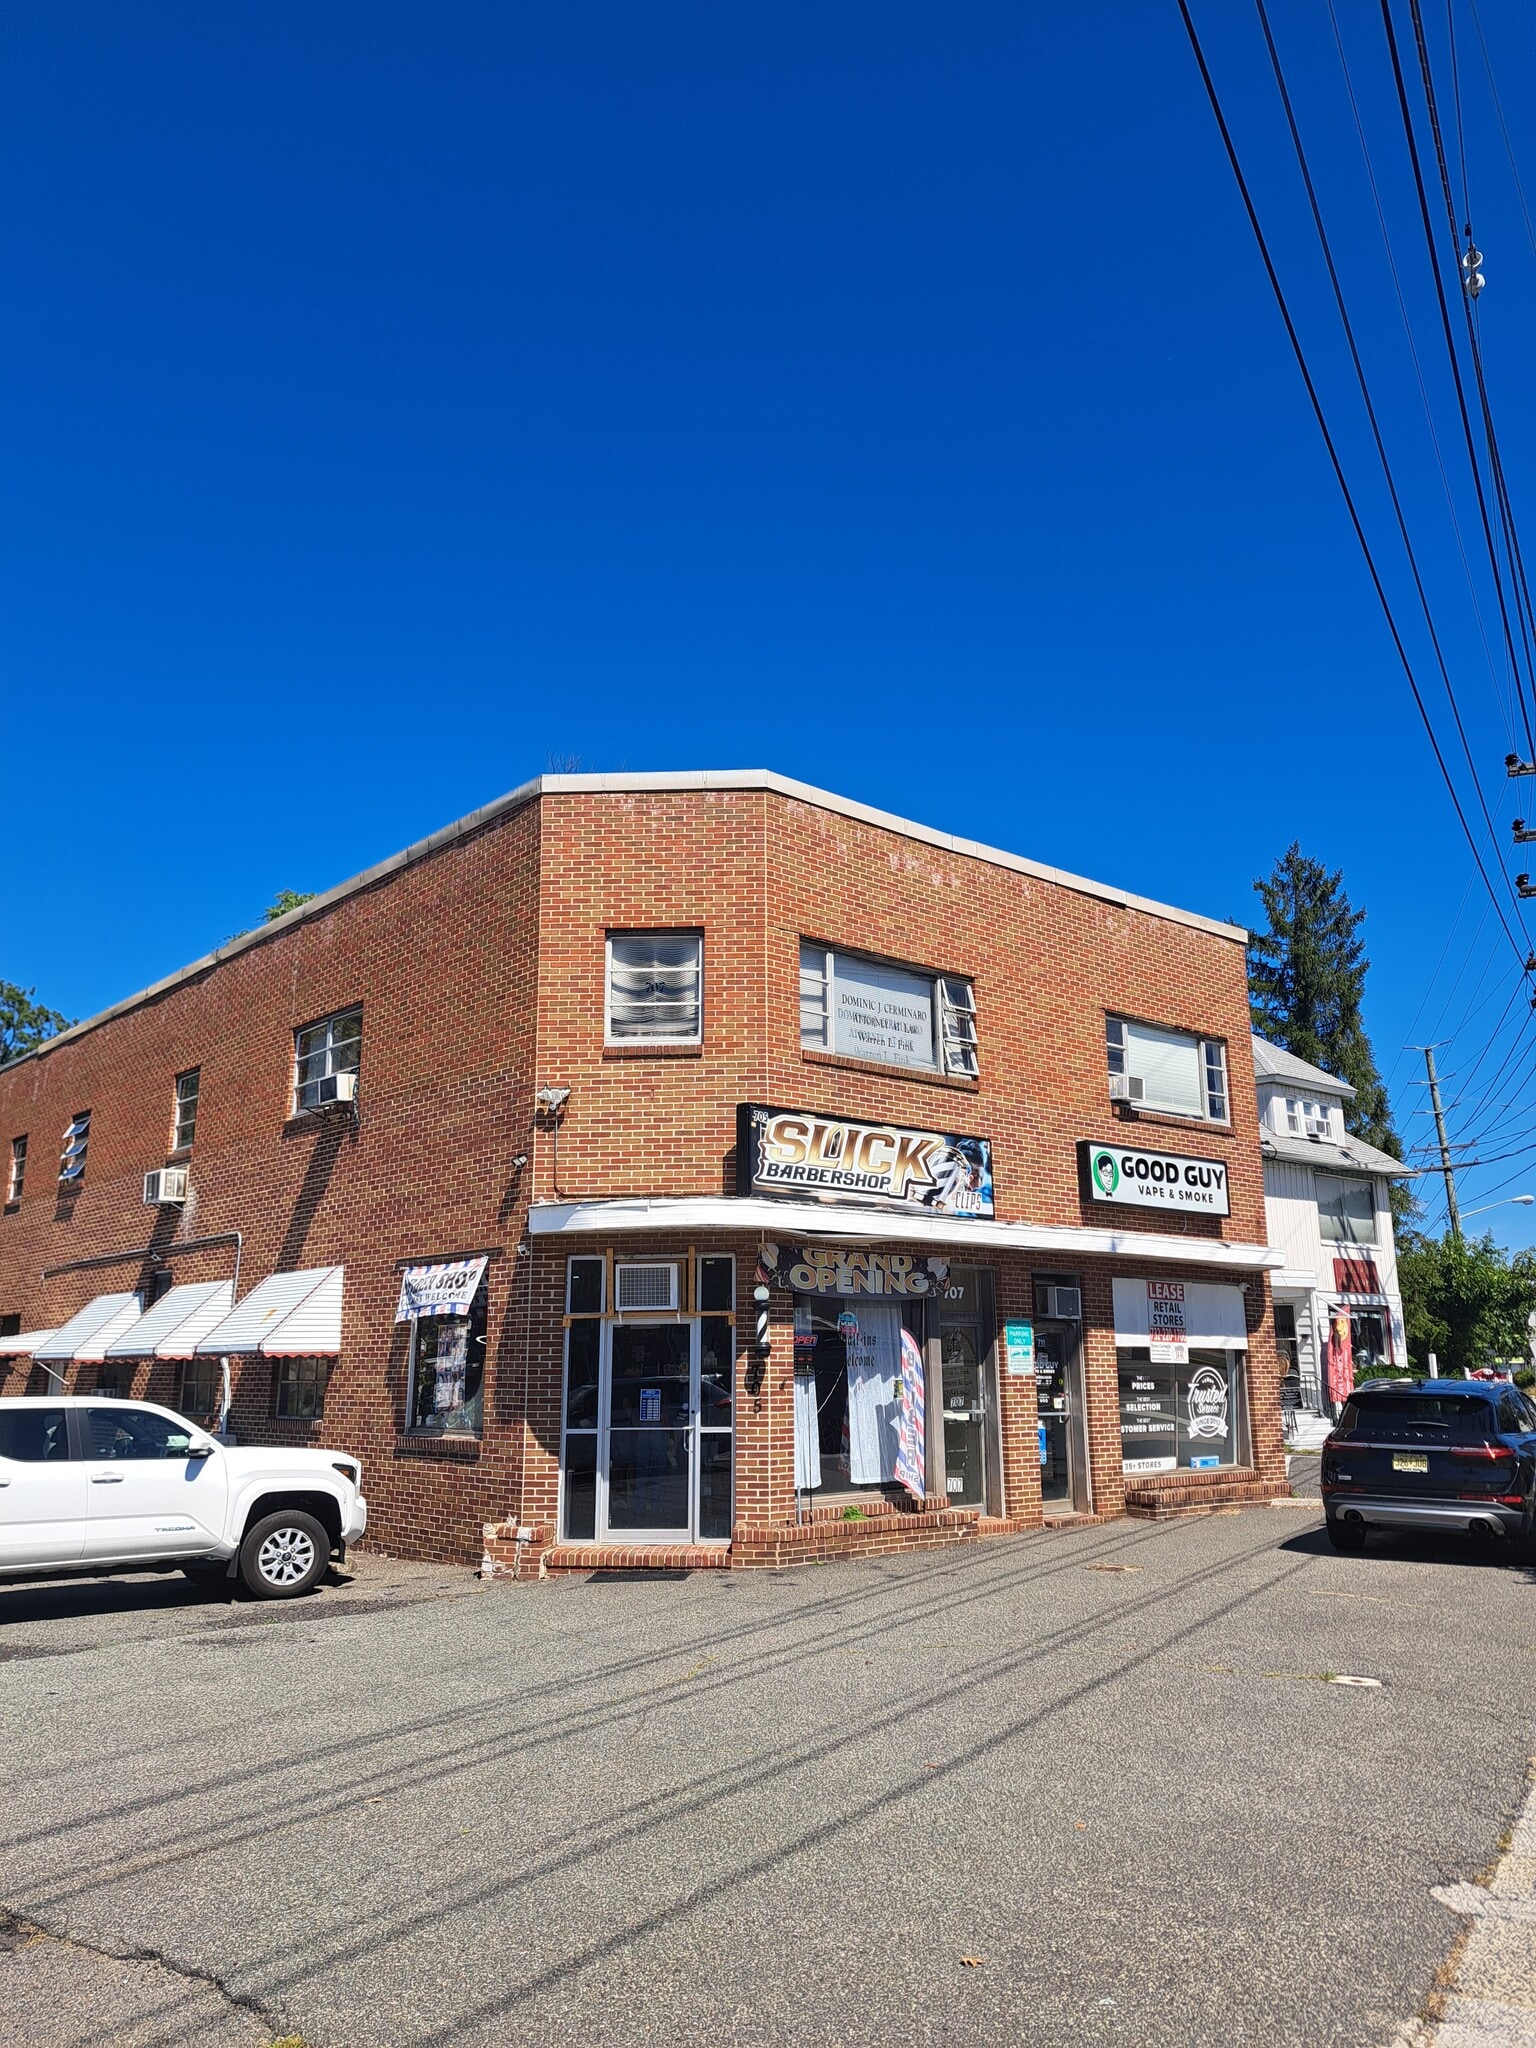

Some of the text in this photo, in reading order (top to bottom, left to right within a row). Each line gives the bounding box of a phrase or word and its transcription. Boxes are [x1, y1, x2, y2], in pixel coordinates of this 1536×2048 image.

[841, 994, 876, 1011] DOMINIC
[884, 1003, 927, 1021] CERMINARO
[858, 1031, 885, 1046] Warren
[898, 1039, 914, 1052] Fink
[753, 1111, 768, 1122] 705
[767, 1119, 941, 1194] SLICK
[766, 1162, 891, 1190] BARBERSHOP
[1121, 1156, 1224, 1190] GOOD GUY
[955, 1191, 982, 1211] CLIPS
[1138, 1184, 1214, 1204] VAPE & SMOKE
[803, 1247, 913, 1273] GRAND
[789, 1264, 929, 1294] OPENING
[1149, 1282, 1184, 1300] LEASE
[1154, 1301, 1182, 1314] RETAIL
[1152, 1314, 1184, 1326] STORES
[847, 1352, 875, 1367] elcome
[1132, 1382, 1155, 1390] PRICES
[1187, 1384, 1228, 1404] Trusted
[1126, 1403, 1161, 1411] SELECTION
[1121, 1424, 1175, 1433] STOMER SERVICE
[1138, 1461, 1162, 1469] STORES
